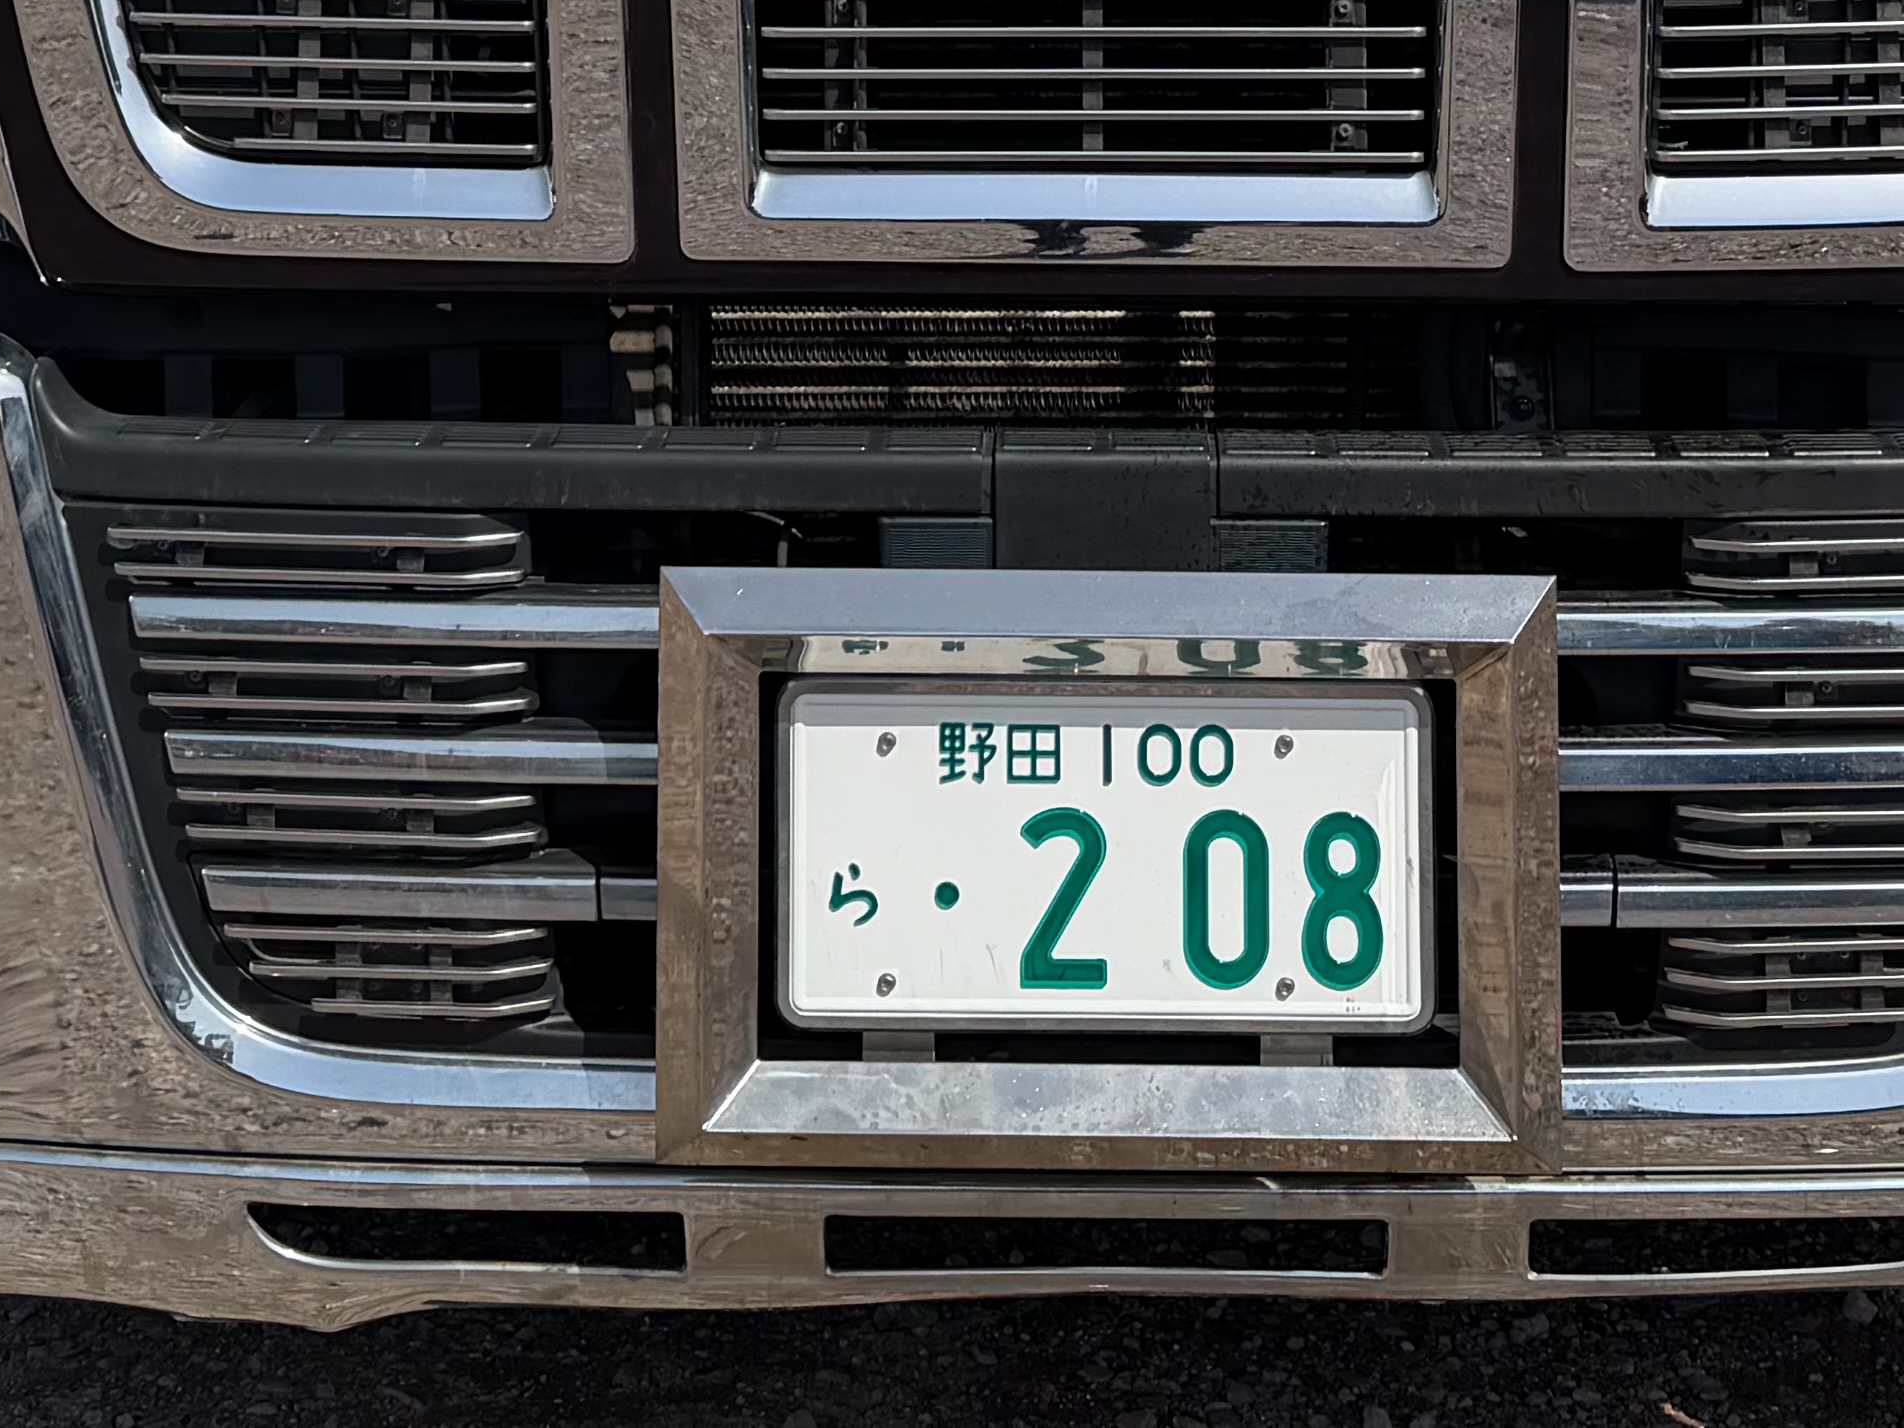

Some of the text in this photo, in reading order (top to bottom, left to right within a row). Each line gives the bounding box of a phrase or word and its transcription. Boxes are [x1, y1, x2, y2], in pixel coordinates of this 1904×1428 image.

[939, 722, 1234, 787] 野田 100
[828, 862, 879, 927] ら
